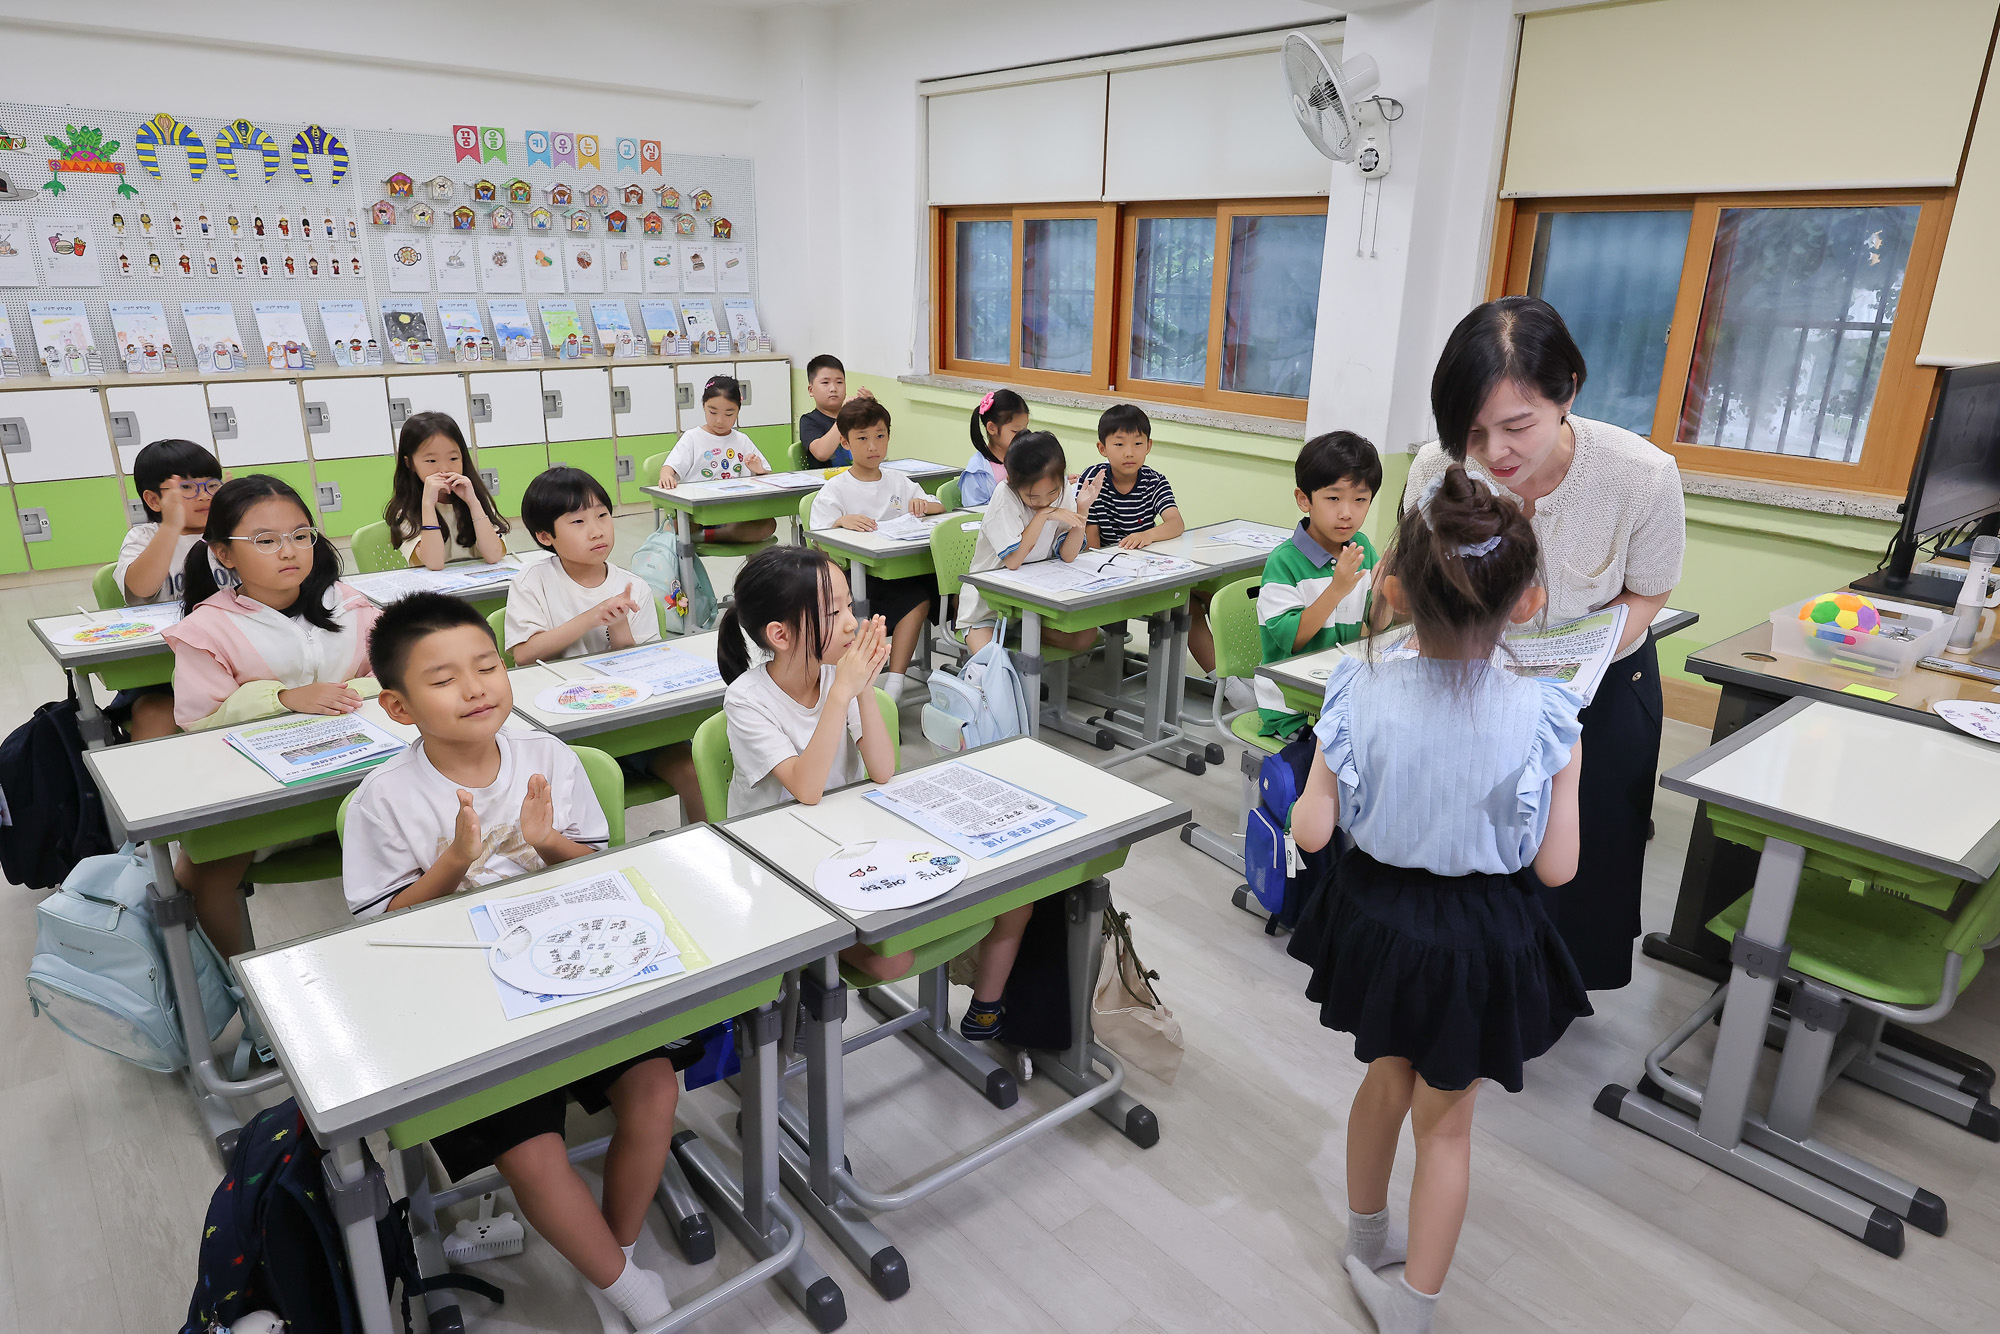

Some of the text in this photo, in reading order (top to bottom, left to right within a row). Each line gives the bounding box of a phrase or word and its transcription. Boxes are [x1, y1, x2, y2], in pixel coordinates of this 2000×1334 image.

[460, 130, 656, 160] 꿈을 키우는 교실
[981, 817, 1056, 848] 매일 운동 기록
